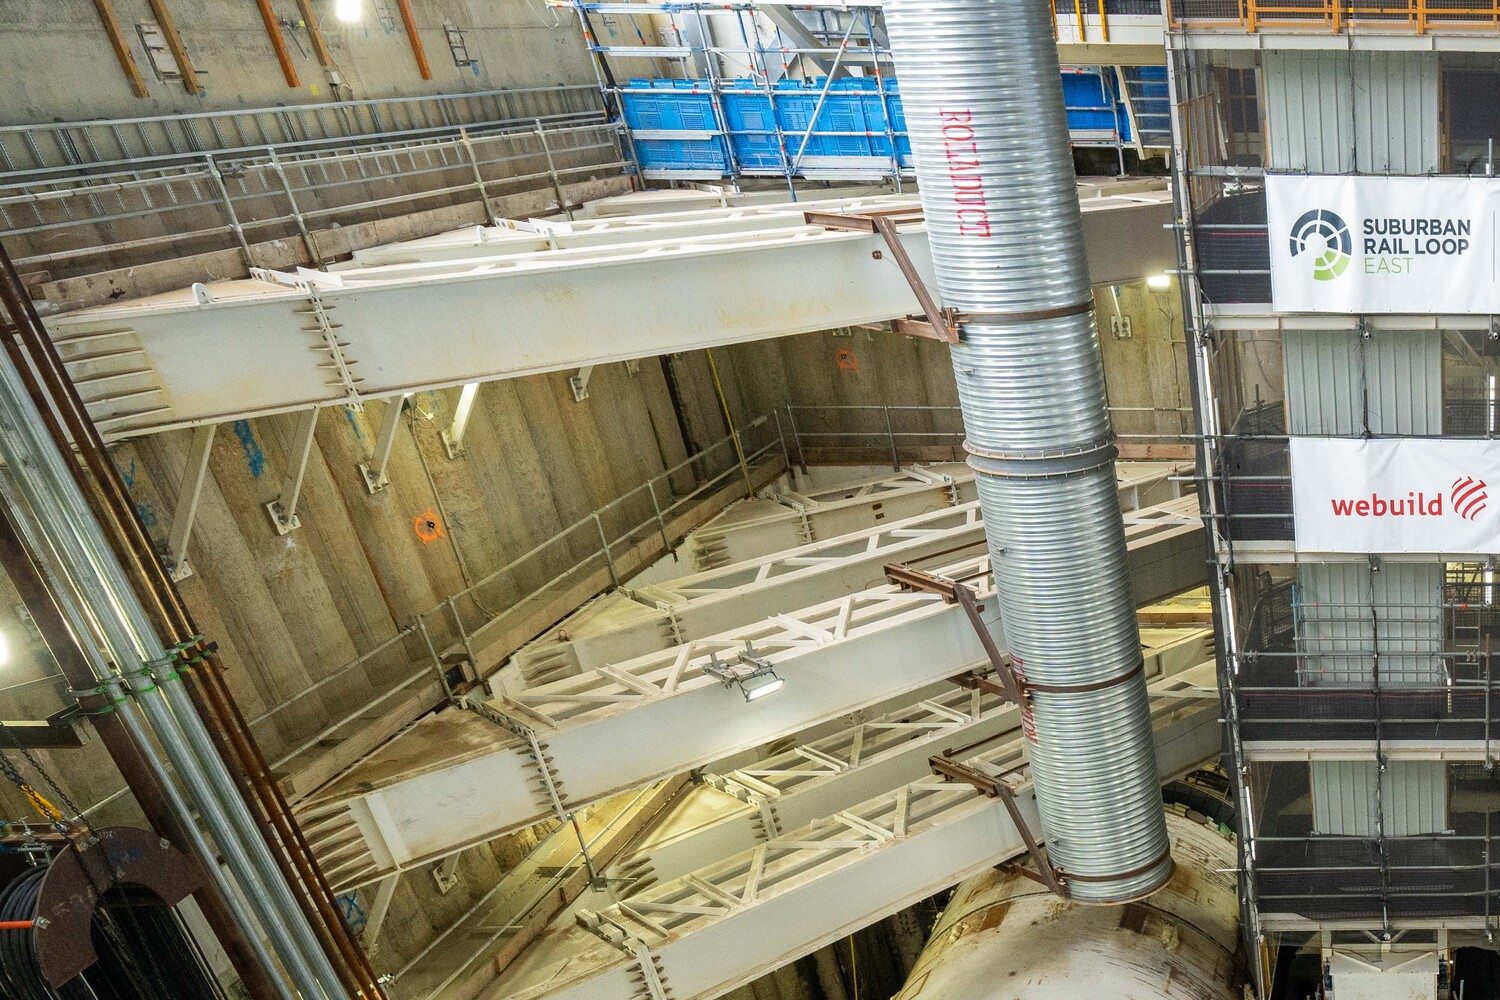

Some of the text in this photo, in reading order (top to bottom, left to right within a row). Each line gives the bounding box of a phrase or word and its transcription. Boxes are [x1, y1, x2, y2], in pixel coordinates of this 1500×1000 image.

[940, 107, 991, 237] ROLADUCT
[1363, 218, 1471, 236] SUBURBAN
[1363, 238, 1469, 255] RAIL LOOP
[1364, 257, 1414, 274] EAST
[1331, 491, 1443, 517] webuild
